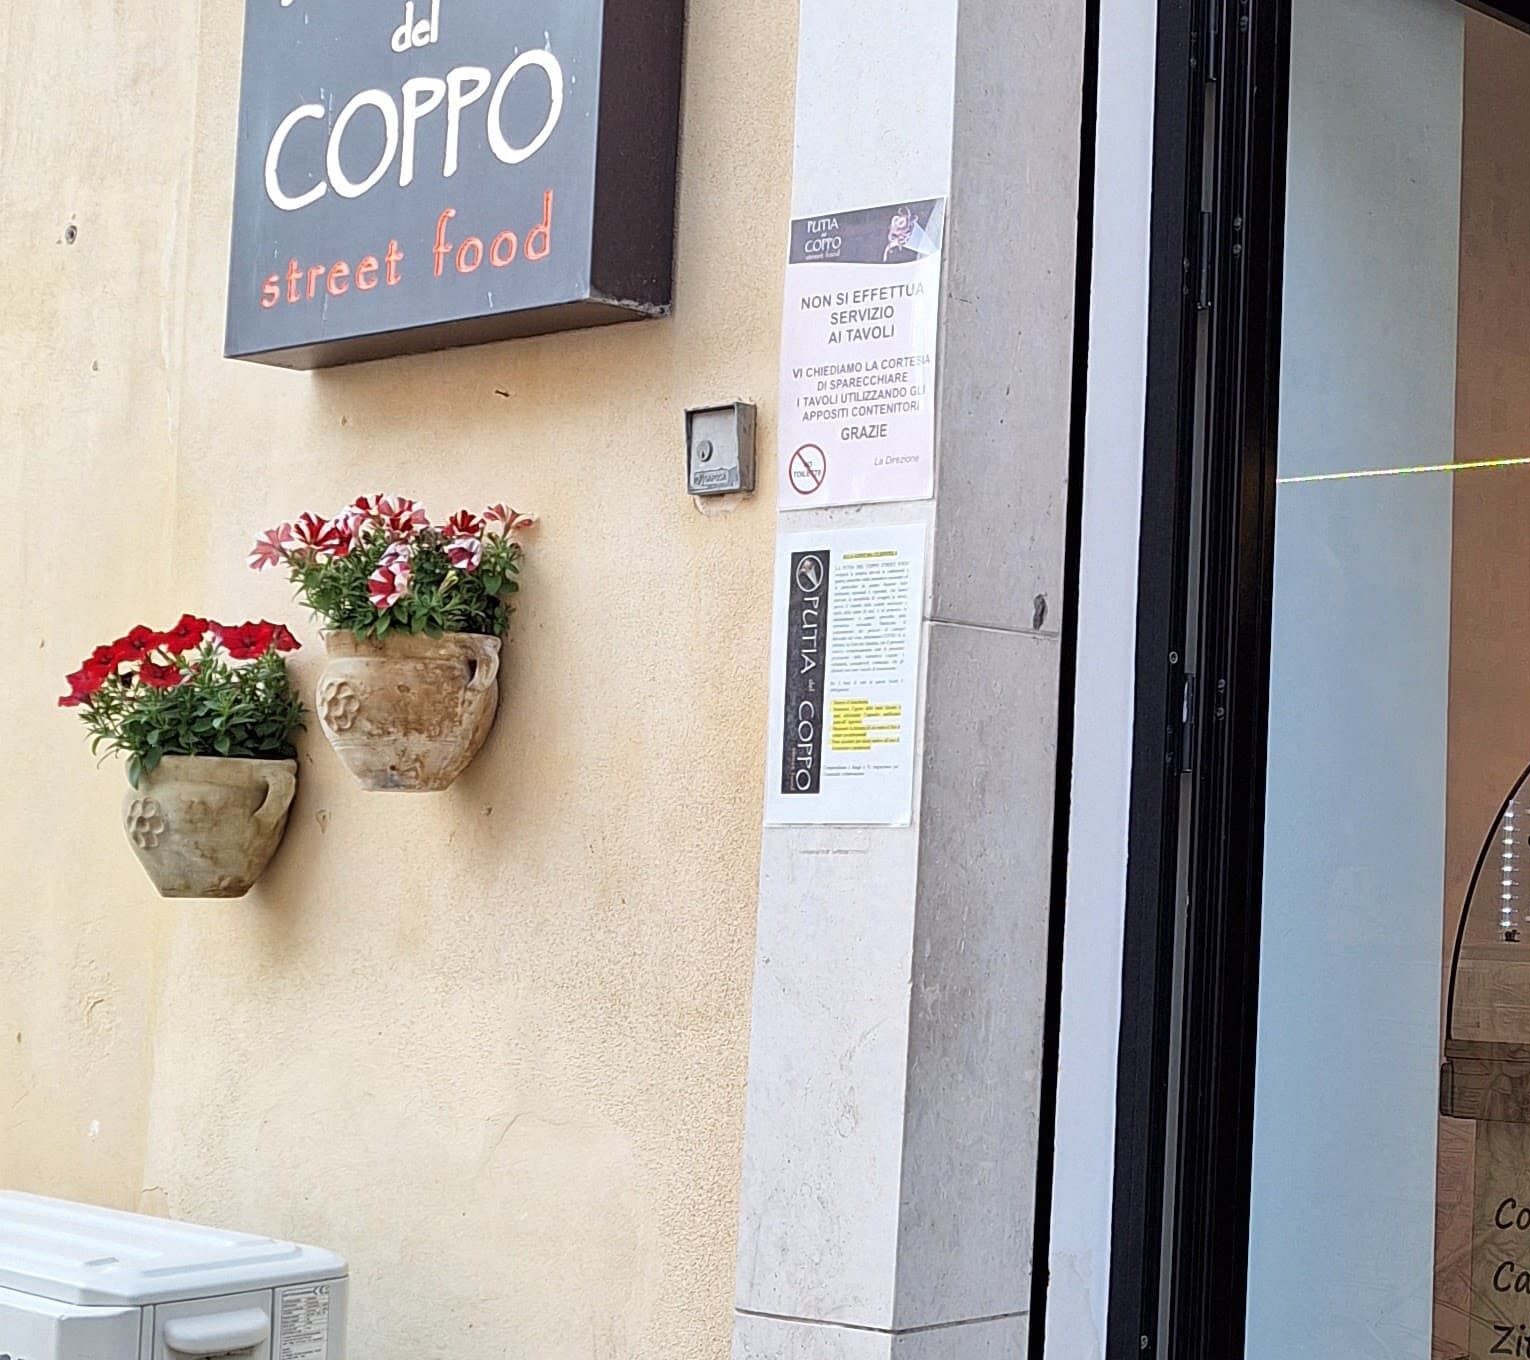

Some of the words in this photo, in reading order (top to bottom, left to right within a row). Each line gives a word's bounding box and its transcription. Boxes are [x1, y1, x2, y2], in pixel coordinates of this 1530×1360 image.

[264, 48, 565, 211] COPPO
[260, 240, 404, 309] street
[433, 189, 553, 277] food
[801, 293, 832, 311] NON
[835, 291, 849, 307] SI
[852, 282, 925, 305] EFFETTUA
[830, 305, 895, 326] SERVIZIO
[828, 328, 843, 345] AI
[845, 324, 895, 343] TAVOLI
[792, 367, 804, 379] VI
[805, 360, 863, 379] CHIEDIAMO
[864, 359, 879, 372] LA
[817, 379, 827, 392] DI
[829, 371, 908, 392] SPARECCHIARE
[802, 393, 839, 409] TAVOLI
[840, 387, 907, 406] UTILIZZANDO
[801, 407, 849, 423] APPOSITI
[840, 423, 888, 441] GRAZIE
[873, 456, 883, 467] La
[800, 595, 821, 675] PUTIA
[794, 699, 816, 791] COPPO
